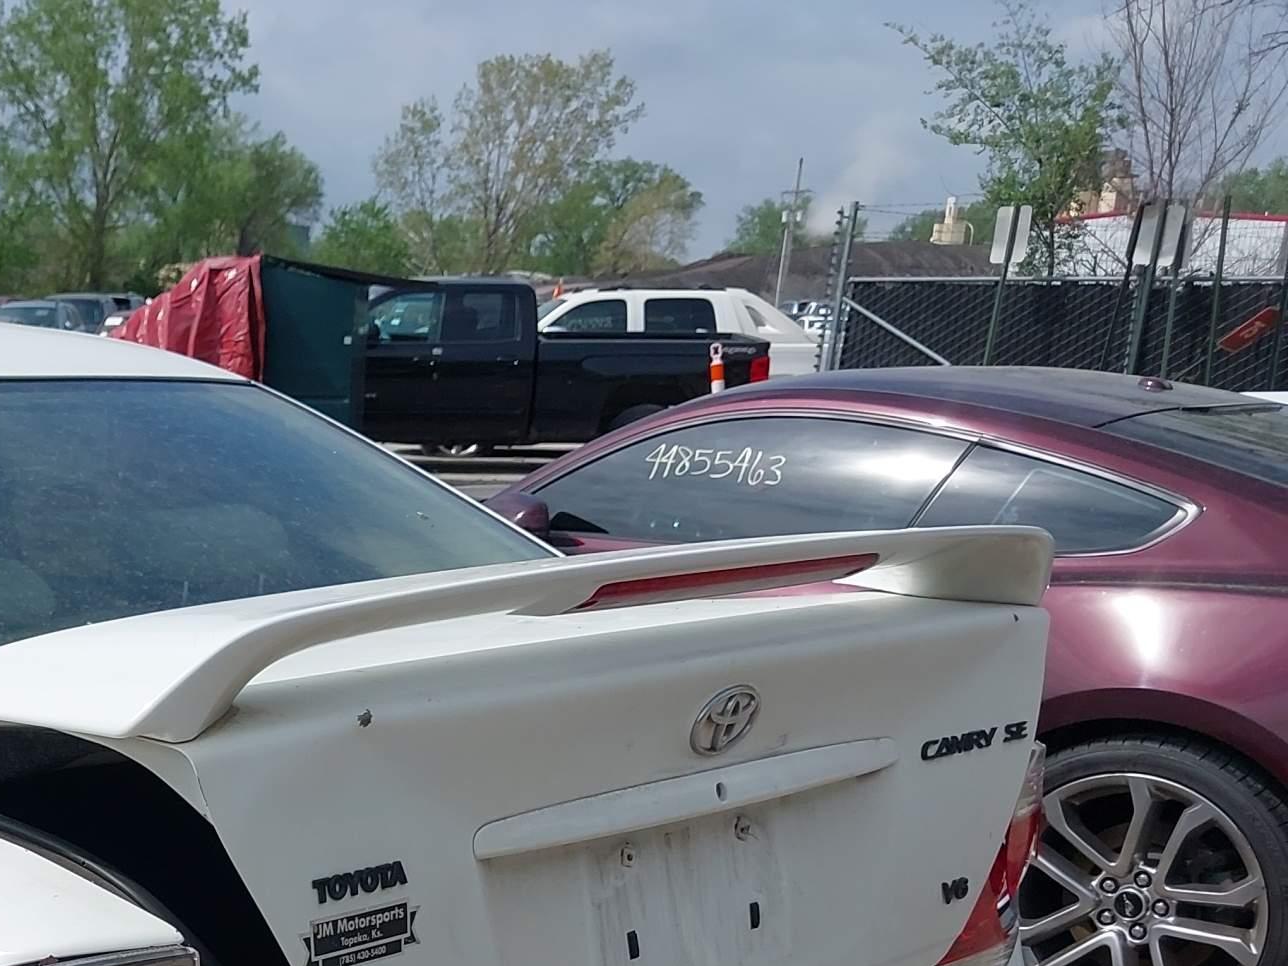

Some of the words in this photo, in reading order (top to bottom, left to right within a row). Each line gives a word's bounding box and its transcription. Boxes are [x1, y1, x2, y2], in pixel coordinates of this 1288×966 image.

[645, 443, 786, 486] 44855463
[921, 727, 998, 761] CAMRY
[1002, 720, 1028, 743] SE
[312, 860, 408, 904] TOYOTA
[941, 877, 969, 905] V6
[317, 922, 334, 939] JM
[337, 907, 404, 934] Motorsports
[340, 932, 370, 947] Topeka,
